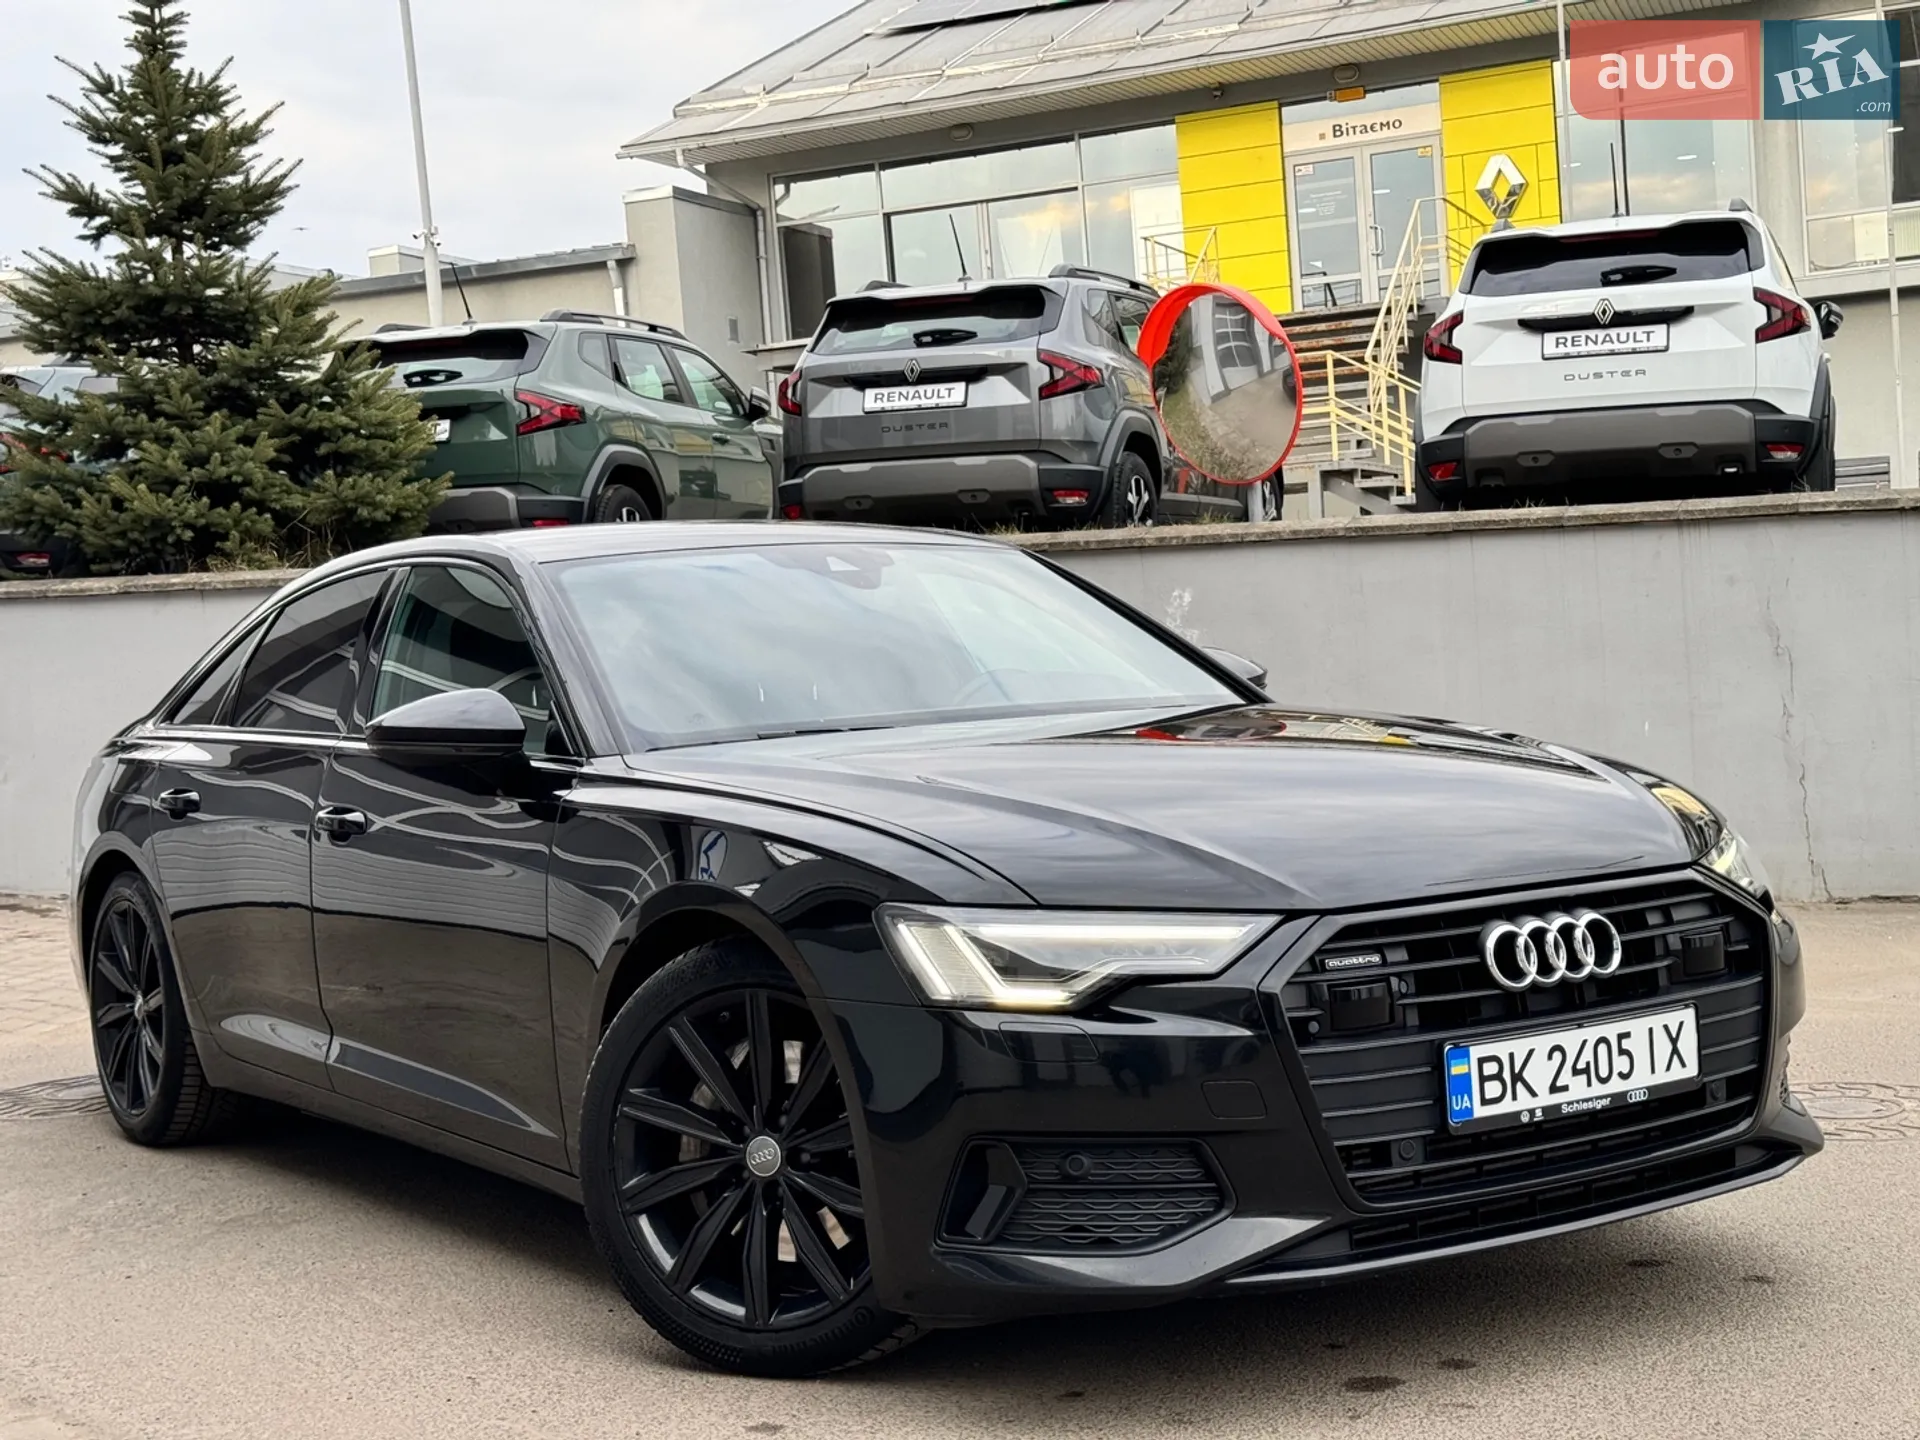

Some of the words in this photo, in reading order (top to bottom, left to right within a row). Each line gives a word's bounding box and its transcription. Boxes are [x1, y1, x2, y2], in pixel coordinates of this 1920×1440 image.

[1332, 118, 1403, 138] Вітаємо
[1555, 331, 1656, 349] RENAULT
[1564, 369, 1647, 381] DUSTER
[873, 387, 955, 404] RENAULT
[881, 422, 948, 434] DUSTER
[1327, 955, 1380, 968] quattro
[1476, 1047, 1539, 1107] BK
[1546, 1031, 1635, 1095] 2405
[1647, 1020, 1688, 1075] IX
[1452, 1093, 1472, 1111] UA
[1560, 1097, 1612, 1114] Schlesiger
